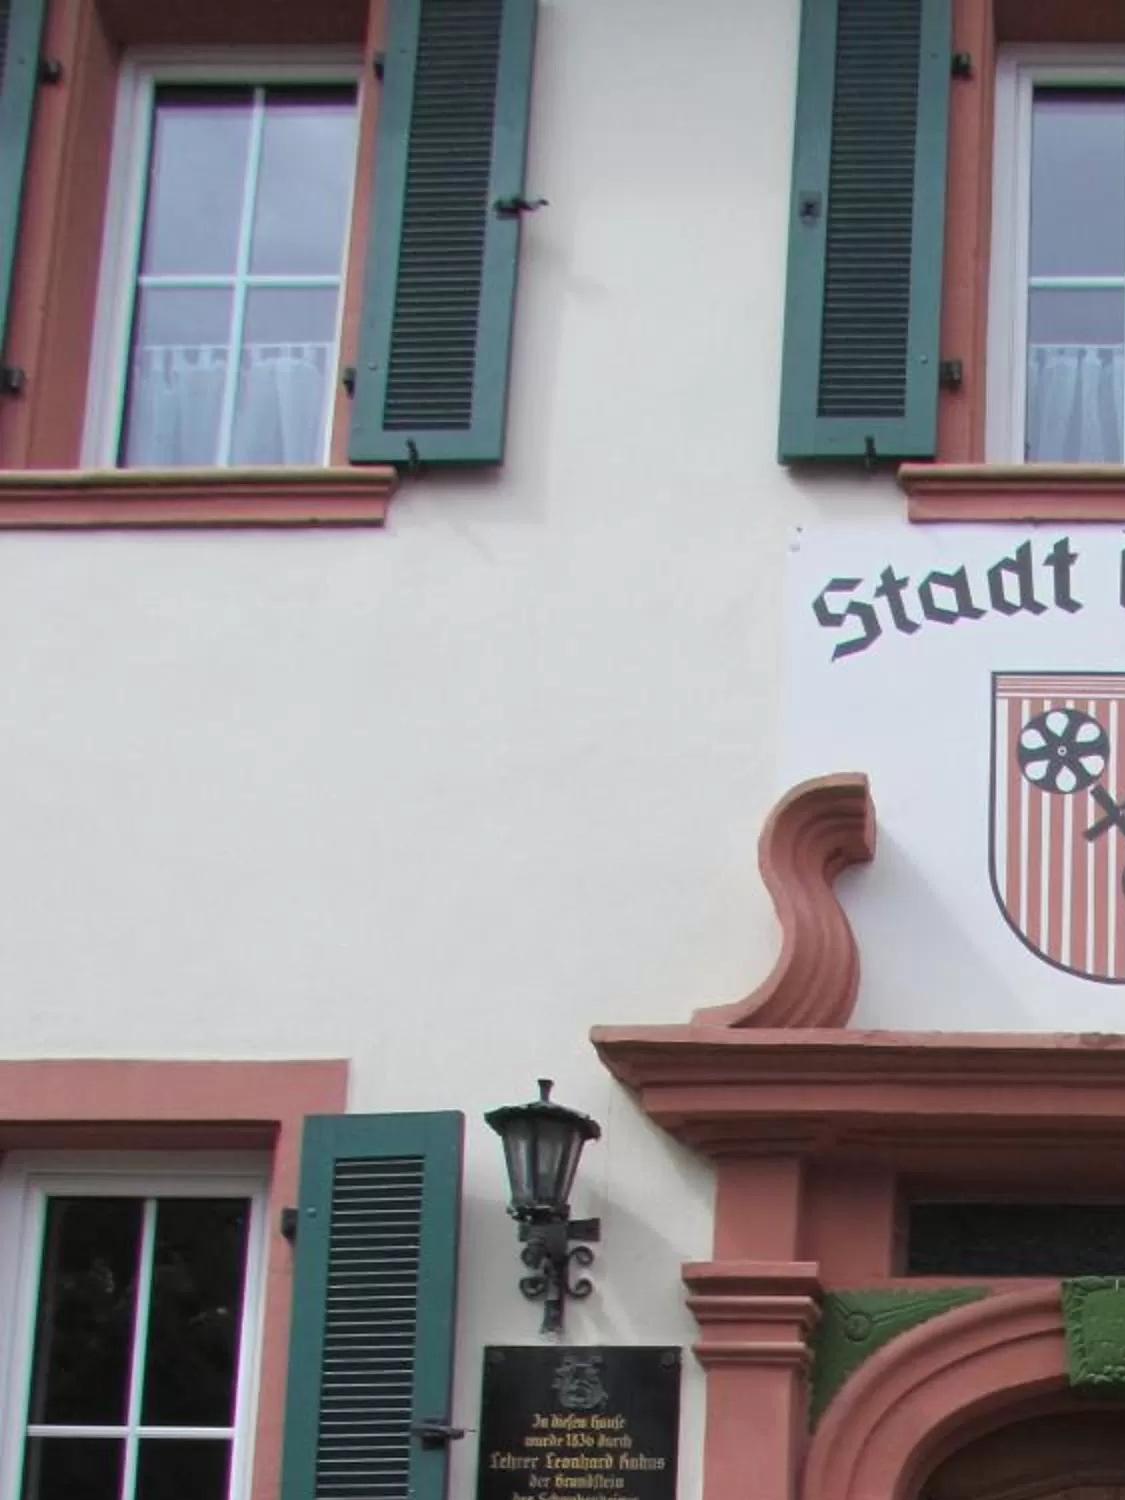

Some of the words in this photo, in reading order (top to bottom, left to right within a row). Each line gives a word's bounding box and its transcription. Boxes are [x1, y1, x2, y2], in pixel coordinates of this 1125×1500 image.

[812, 536, 1084, 662] Stadt
[597, 1433, 633, 1449] durch
[489, 1453, 539, 1471] Lehrer
[545, 1452, 613, 1472] Leonhard
[529, 1474, 550, 1488] der
